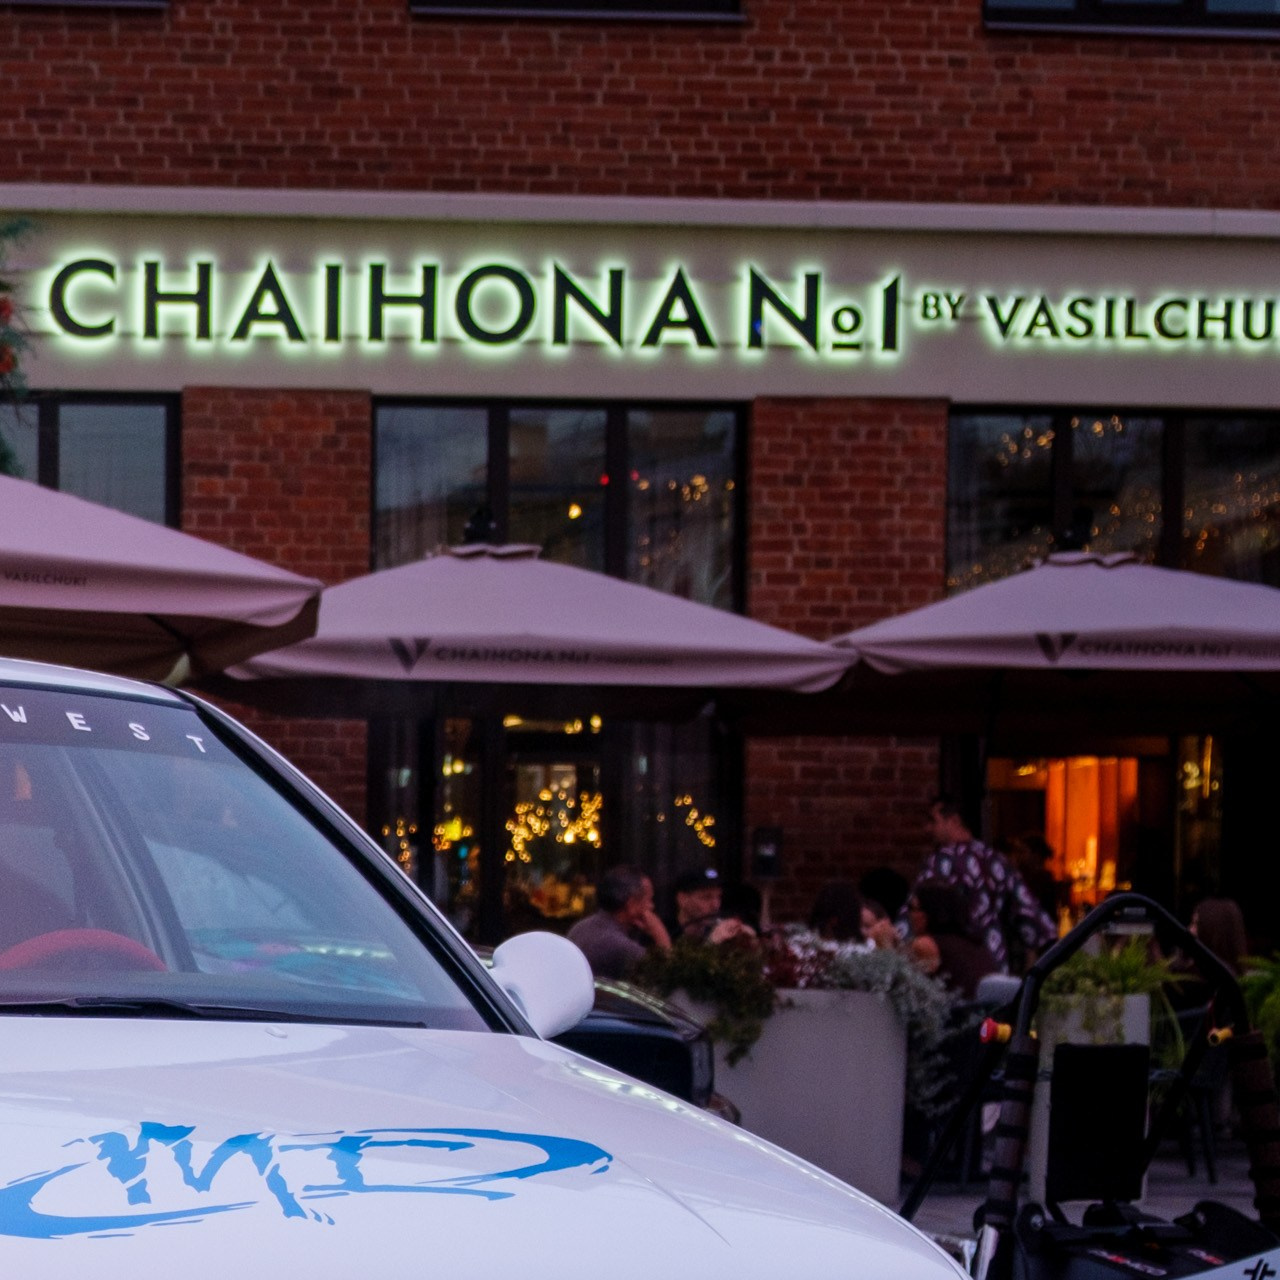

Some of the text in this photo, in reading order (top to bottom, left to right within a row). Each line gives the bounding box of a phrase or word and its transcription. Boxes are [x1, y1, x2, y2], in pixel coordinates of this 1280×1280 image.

[48, 258, 718, 348] CHAIHONA
[921, 293, 964, 320] BY
[984, 295, 1277, 340] VASILCHU
[0, 703, 207, 754] WEST
